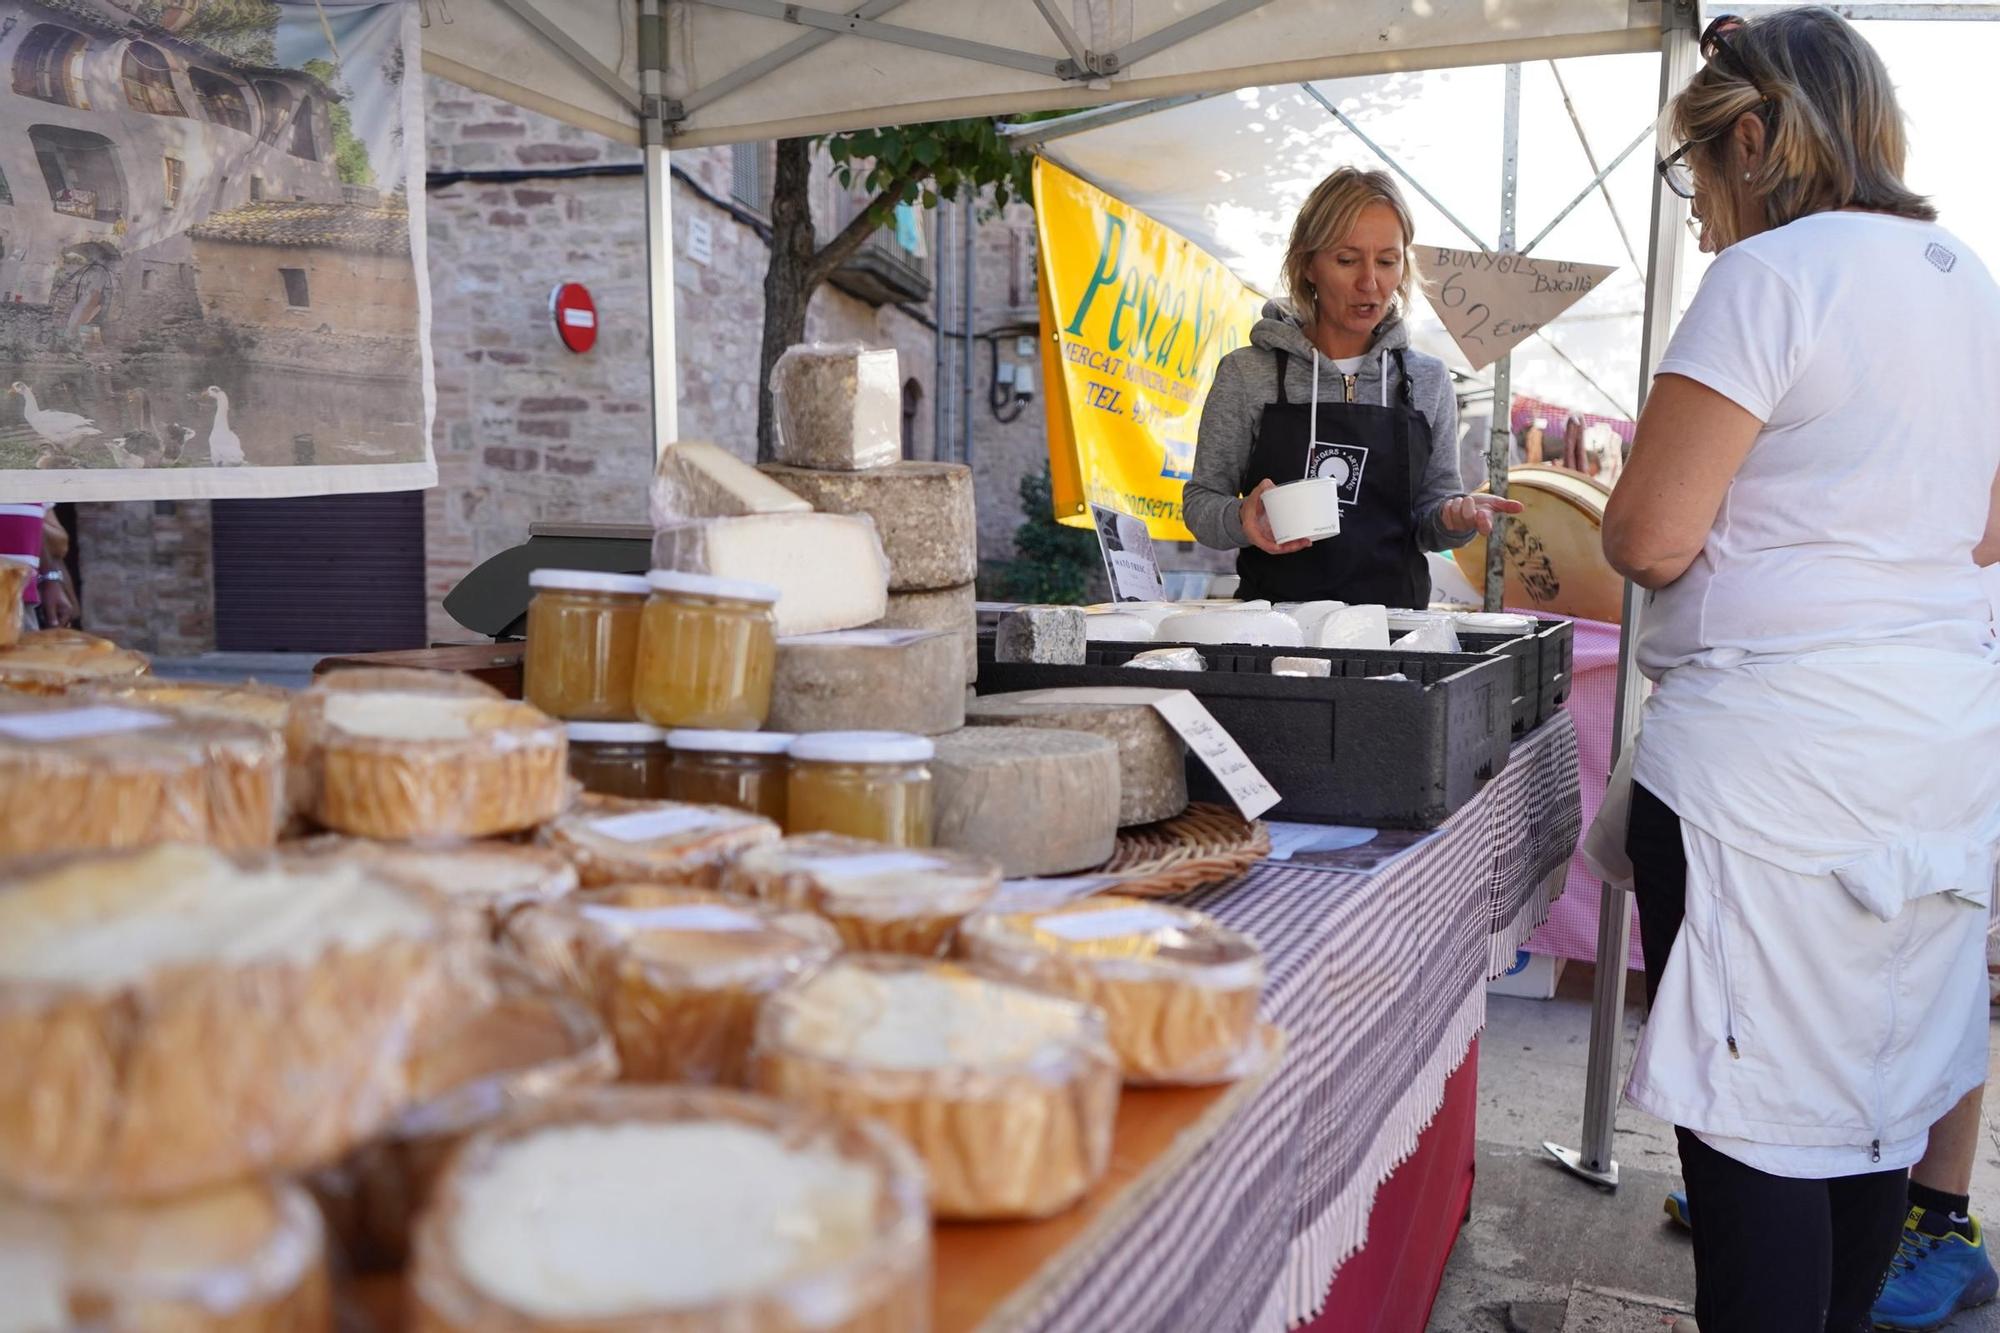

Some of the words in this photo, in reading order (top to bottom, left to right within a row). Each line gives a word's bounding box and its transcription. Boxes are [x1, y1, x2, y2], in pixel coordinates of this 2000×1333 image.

[1434, 248, 1538, 276] BUNYOLS
[1557, 261, 1577, 274] DE
[1064, 212, 1186, 369] Pesca
[1441, 272, 1466, 307] 6
[1461, 303, 1490, 345] 2
[1086, 380, 1123, 415] TEL.
[1346, 454, 1360, 491] ARTESANS
